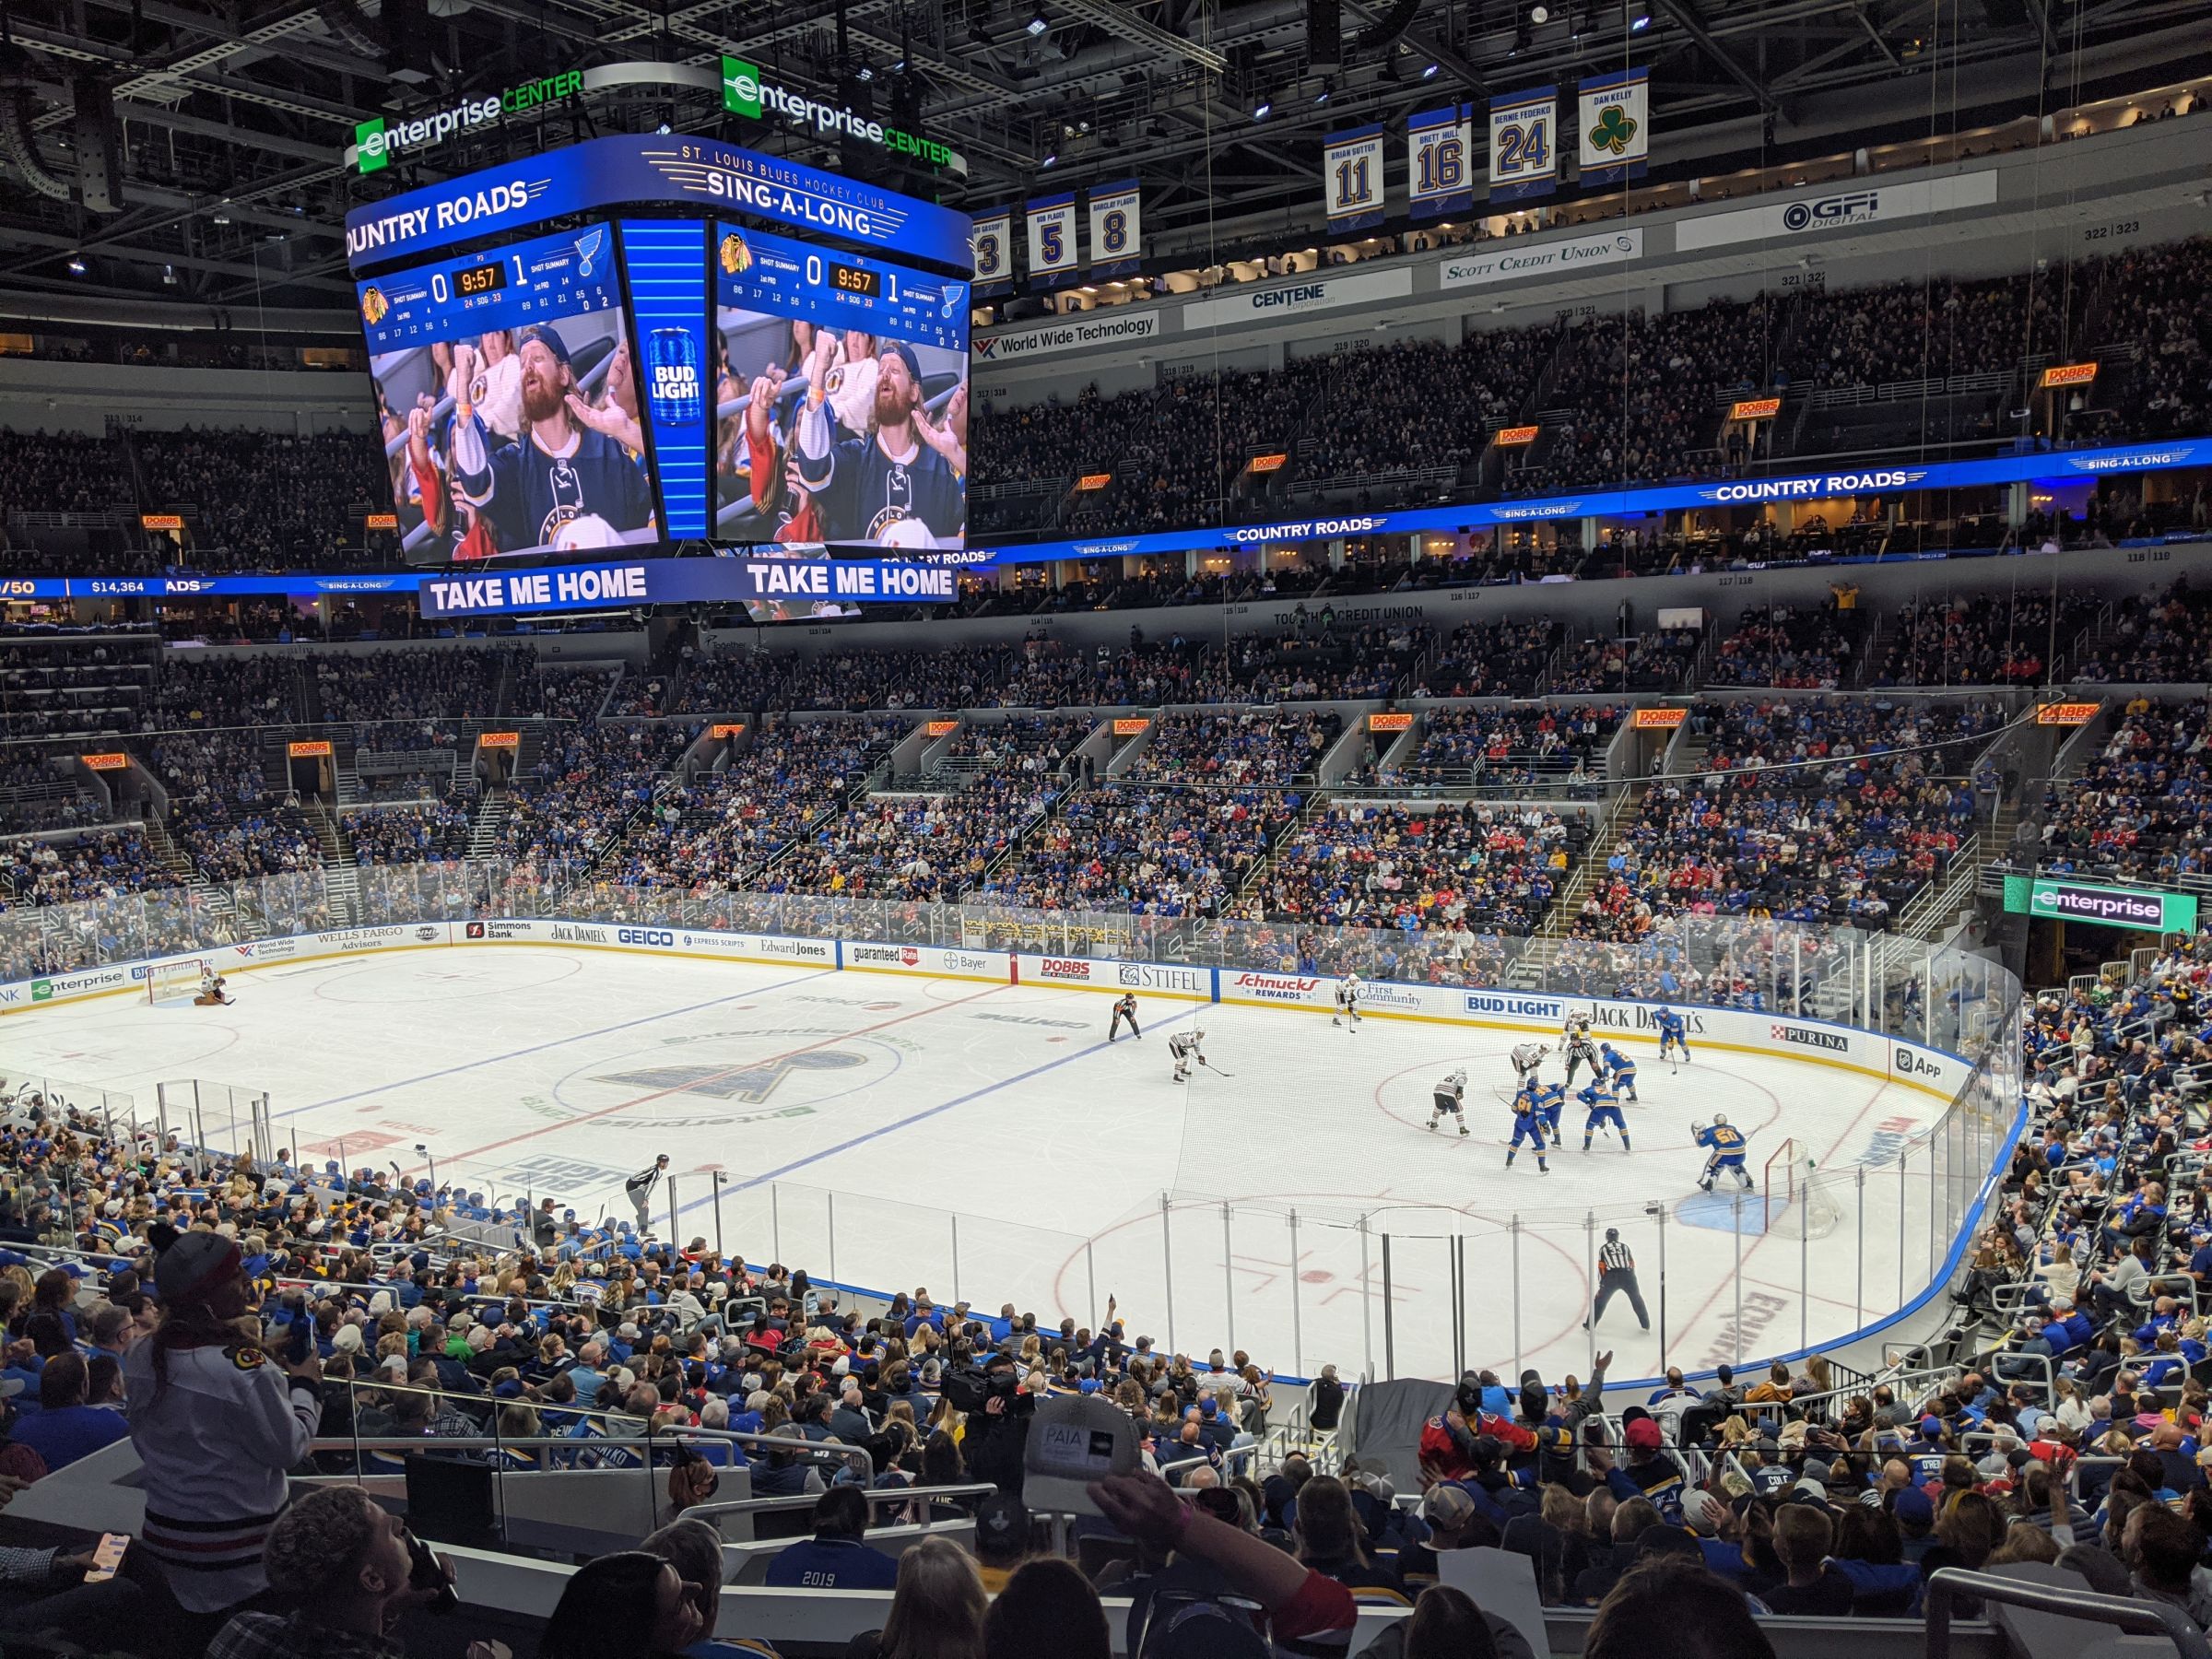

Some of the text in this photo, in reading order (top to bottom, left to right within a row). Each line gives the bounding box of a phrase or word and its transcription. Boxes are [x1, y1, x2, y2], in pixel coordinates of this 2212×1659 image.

[1594, 90, 1632, 105] DAN KELLY
[358, 70, 582, 156] enterprise CENTER
[724, 75, 952, 165] enterprise CENTER
[1495, 105, 1550, 125] BERNIE FEDERKO
[1419, 128, 1459, 146] BRETT HULL
[1331, 143, 1376, 160] BRIAN SUTTER
[1497, 118, 1550, 176] 24
[1417, 138, 1464, 194] 16
[682, 146, 885, 210] ST. LOUIS BLUES HOCKEY CLUB
[1335, 156, 1372, 208] 11
[437, 181, 528, 229] ROADS
[707, 171, 871, 235] SING-A-LONG
[1093, 195, 1136, 212] BARCLAY PLAGER
[1036, 210, 1065, 224] BOB PLAGER
[1811, 212, 1877, 229] DIGITAL
[1102, 209, 1127, 253] 8
[2084, 221, 2140, 241] 322 323
[1041, 221, 1064, 265] 5
[977, 233, 1000, 276] 3
[512, 254, 528, 287] 1
[546, 258, 570, 270] SUMMARY
[759, 256, 800, 273] SHOT SUMMARY
[806, 255, 821, 286] 0
[462, 267, 495, 292] 9:57
[561, 277, 570, 286] 14
[838, 267, 871, 291] 9:57
[1782, 276, 1800, 286] 321
[431, 273, 448, 303] 0
[558, 286, 602, 303] 21 55 6
[888, 274, 899, 302] 1
[465, 292, 501, 308] 24 SOG 33
[602, 296, 608, 307] 2
[753, 288, 816, 310] 17 12 56 5
[836, 292, 873, 308] 24 SOG 33
[1252, 284, 1325, 309] CENTENE
[1288, 296, 1335, 311] Corporation
[1580, 305, 1595, 315] 321
[394, 328, 402, 337] 17
[410, 324, 418, 335] 12
[442, 318, 448, 327] 5
[920, 323, 928, 332] 21
[1001, 318, 1154, 353] World Wide Technology
[954, 339, 959, 349] 2
[1334, 338, 1370, 350] 319 320
[654, 366, 695, 382] BUD
[1163, 364, 1194, 376] 318 319
[2049, 365, 2095, 379] DOBBS
[652, 382, 700, 399] LIGHT
[977, 387, 1007, 398] 317 318
[1738, 401, 1778, 412] DOBBS
[1501, 427, 1537, 439] DOBBS
[2088, 454, 2171, 470] SING-A-LONG
[1715, 471, 1907, 501] COUNTRY ROADS
[1504, 506, 1566, 518] SING-A-LONG
[145, 516, 181, 525] DOBBS
[1236, 517, 1373, 541] COUNTRY ROADS
[943, 551, 986, 564] ROADS
[1083, 545, 1128, 554] SING-A-LONG
[2128, 551, 2170, 561] 118 119
[91, 581, 145, 594] $14,364
[747, 564, 953, 595] TAKE ME HOME
[1718, 576, 1753, 585] 117 118
[429, 567, 647, 610] TAKE ME HOME
[1338, 606, 1423, 621] CREDIT UNION
[1372, 715, 1410, 725] DOBBS
[1641, 710, 1686, 721] DOBBS
[1116, 721, 1148, 730] DOBBS
[481, 735, 517, 744] DOBBS
[291, 744, 330, 753] DOBBS
[84, 755, 123, 765] DOBBS
[2033, 891, 2160, 918] enterprise
[415, 928, 440, 937] NHL
[488, 922, 532, 931] Simmons
[488, 930, 513, 938] Bank
[551, 924, 606, 943] JACK DANIEL'S
[317, 926, 404, 944] WELLS FARGO
[618, 929, 674, 947] GEICO
[693, 937, 745, 948] EXPRESS SCRIPTS
[257, 941, 276, 949] World
[257, 946, 295, 956] Technology
[340, 939, 382, 950] Advisors
[761, 938, 826, 956] Edward Jones
[853, 947, 918, 962] guaranteed Rate
[960, 956, 986, 971] Bayer
[1041, 959, 1090, 975] DOBBS
[32, 971, 124, 996] enterprise
[1142, 966, 1202, 991] STIFEL
[1255, 989, 1301, 1000] REWARDS
[1357, 988, 1422, 1006] Community
[1368, 983, 1394, 995] First
[1467, 996, 1560, 1018] BUD LIGHT
[1591, 1002, 1630, 1029] JACK
[1787, 1028, 1846, 1051] PURINA
[802, 1571, 836, 1587] 2019
